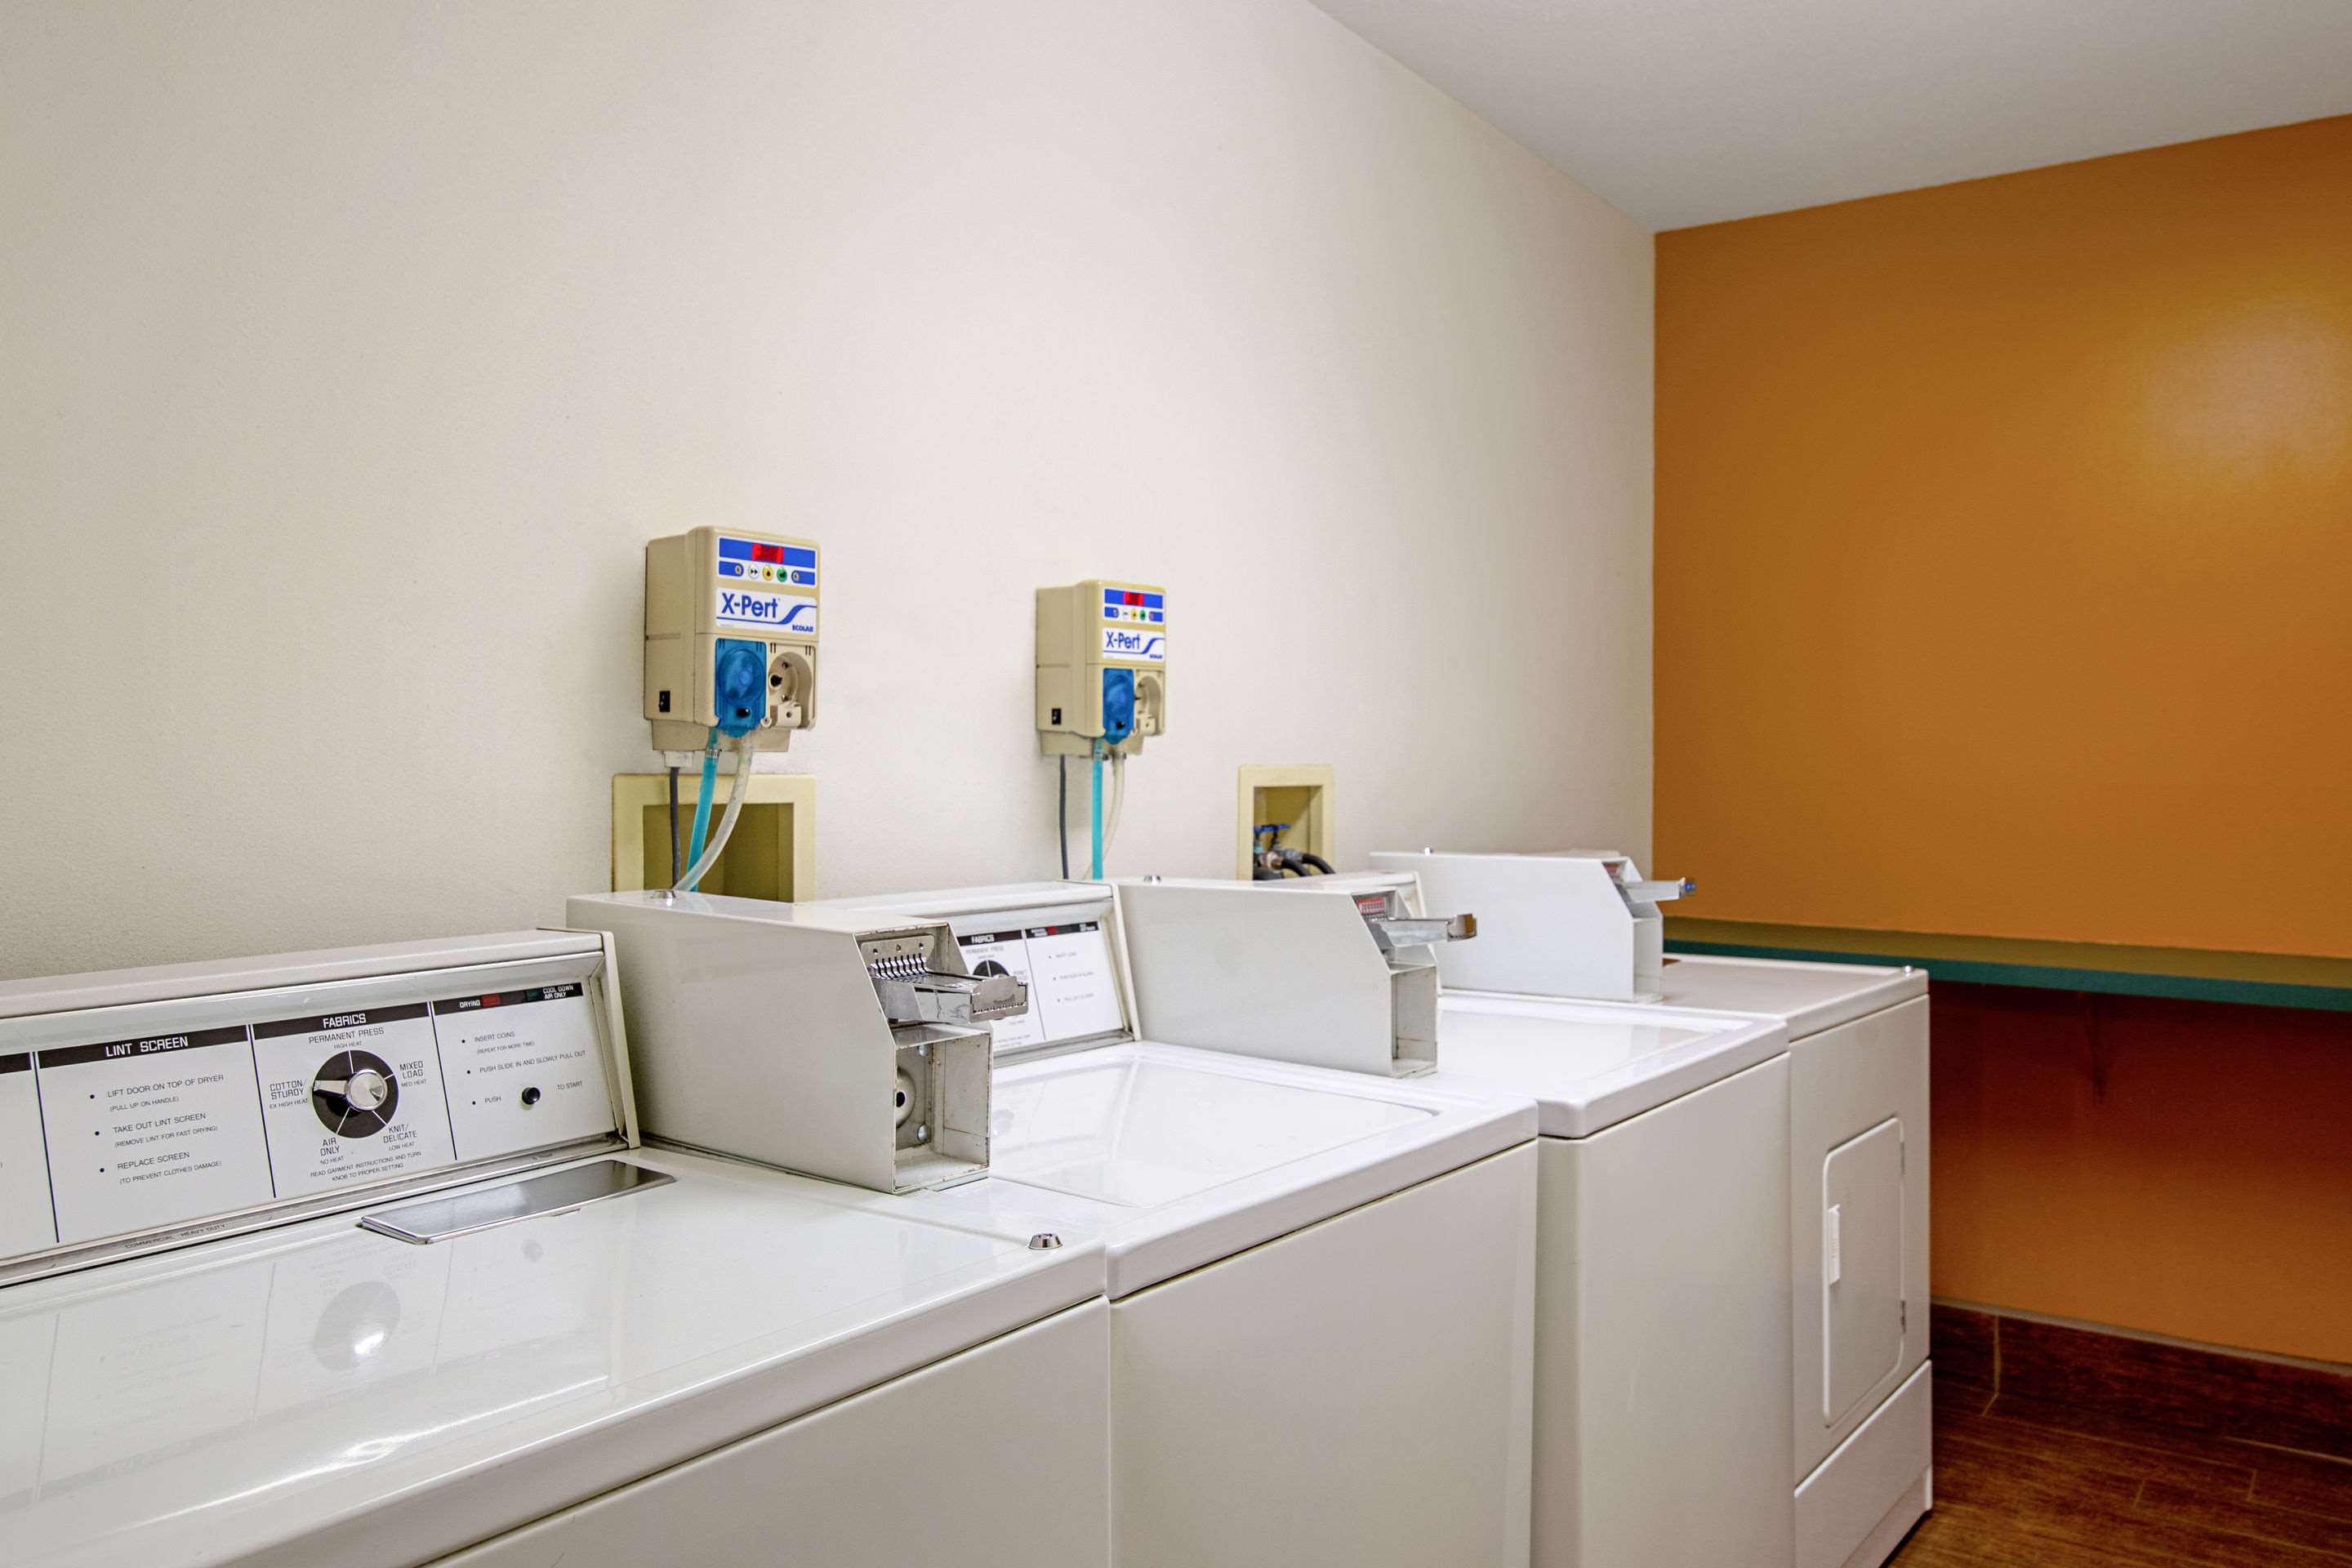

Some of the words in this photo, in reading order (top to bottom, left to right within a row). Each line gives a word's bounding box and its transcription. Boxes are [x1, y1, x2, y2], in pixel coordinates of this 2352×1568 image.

[722, 592, 777, 618] X-Pert
[1107, 631, 1139, 649] X-Pert
[460, 1000, 480, 1009] DRYING
[323, 1013, 367, 1028] FABRICS
[309, 1031, 355, 1044] PERMANENT
[359, 1027, 384, 1037] PRESS
[474, 1034, 495, 1042] INSERT
[497, 1031, 514, 1039] COINS
[105, 1043, 132, 1057] LINT
[140, 1036, 188, 1054] SCREEN
[399, 1061, 424, 1071] MIXED
[537, 1055, 558, 1065] SLOWLY
[403, 1069, 424, 1079] LOAD
[108, 1088, 124, 1098] LIFT
[127, 1085, 151, 1095] DOOR
[153, 1083, 165, 1091] ON
[167, 1080, 182, 1089] TOP
[185, 1078, 196, 1086] OF
[198, 1075, 224, 1085] DRYER
[270, 1080, 307, 1092] COTTON/
[566, 1080, 582, 1089] START
[271, 1089, 304, 1100] STURDY
[109, 1102, 128, 1112] (PULL
[152, 1096, 180, 1106] HANDLE)
[114, 1124, 133, 1134] TAKE
[136, 1120, 153, 1130] OUT
[155, 1117, 172, 1127] LINT
[174, 1112, 206, 1124] SCREEN
[389, 1124, 409, 1134] KNIT/
[114, 1137, 144, 1148] (REMOVE
[145, 1134, 159, 1143] LINT
[162, 1132, 174, 1140] FOR
[176, 1129, 191, 1138] FAST
[323, 1138, 337, 1147] AIR
[383, 1131, 417, 1144] DELICATE
[321, 1146, 341, 1156] ONLY
[118, 1158, 155, 1169] REPLACE
[157, 1152, 190, 1164] SCREEN
[327, 1165, 354, 1174] GARMENT
[355, 1156, 394, 1169] INSTRUCTIONS
[119, 1177, 131, 1185] (TO
[132, 1171, 162, 1183] PREVENT
[163, 1165, 193, 1177] CLOTHES
[194, 1160, 222, 1173] DAMAGE)
[359, 1167, 381, 1176] PROPER
[382, 1162, 404, 1172] SETTING
